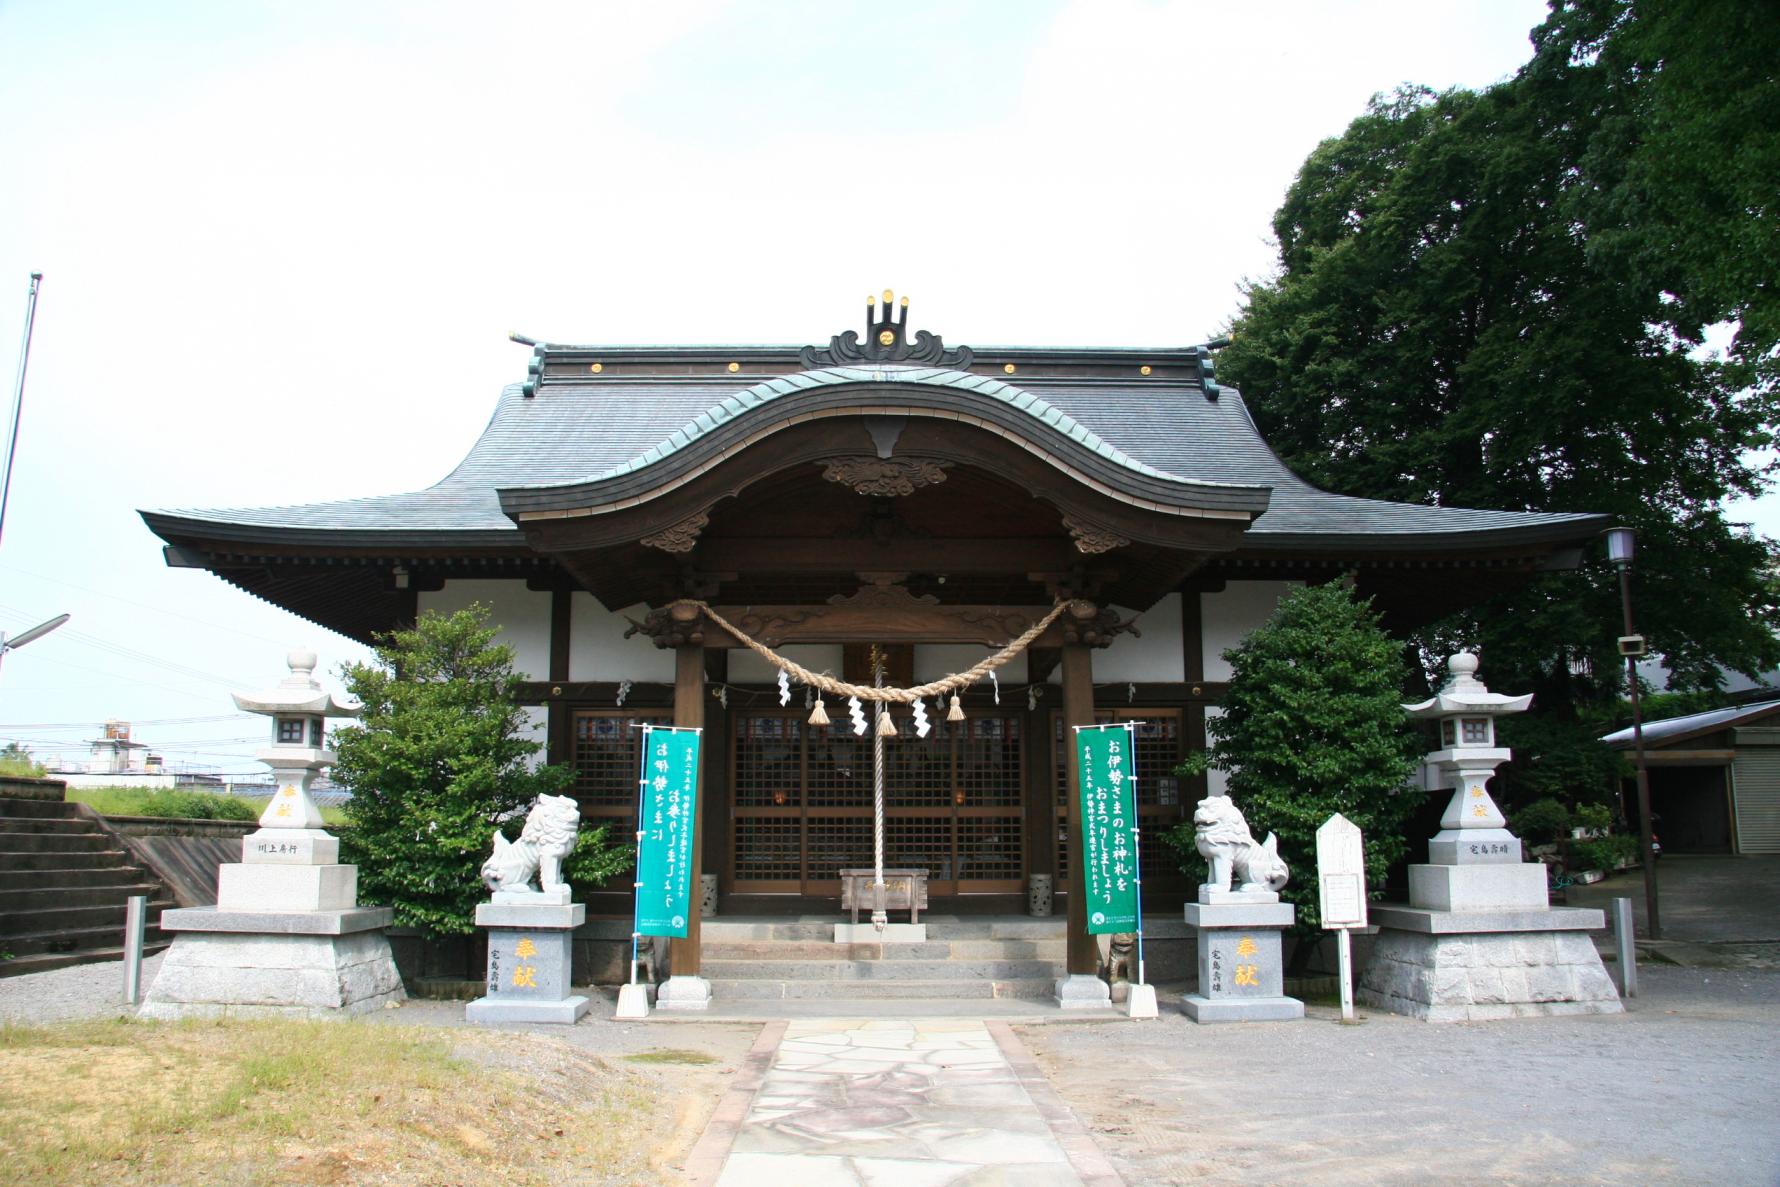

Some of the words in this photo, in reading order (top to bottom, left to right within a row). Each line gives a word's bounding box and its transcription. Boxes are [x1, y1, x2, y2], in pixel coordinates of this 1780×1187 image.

[1096, 787, 1113, 904] おまつりしましょう
[1107, 740, 1129, 892] お伊勢さまのお神札を
